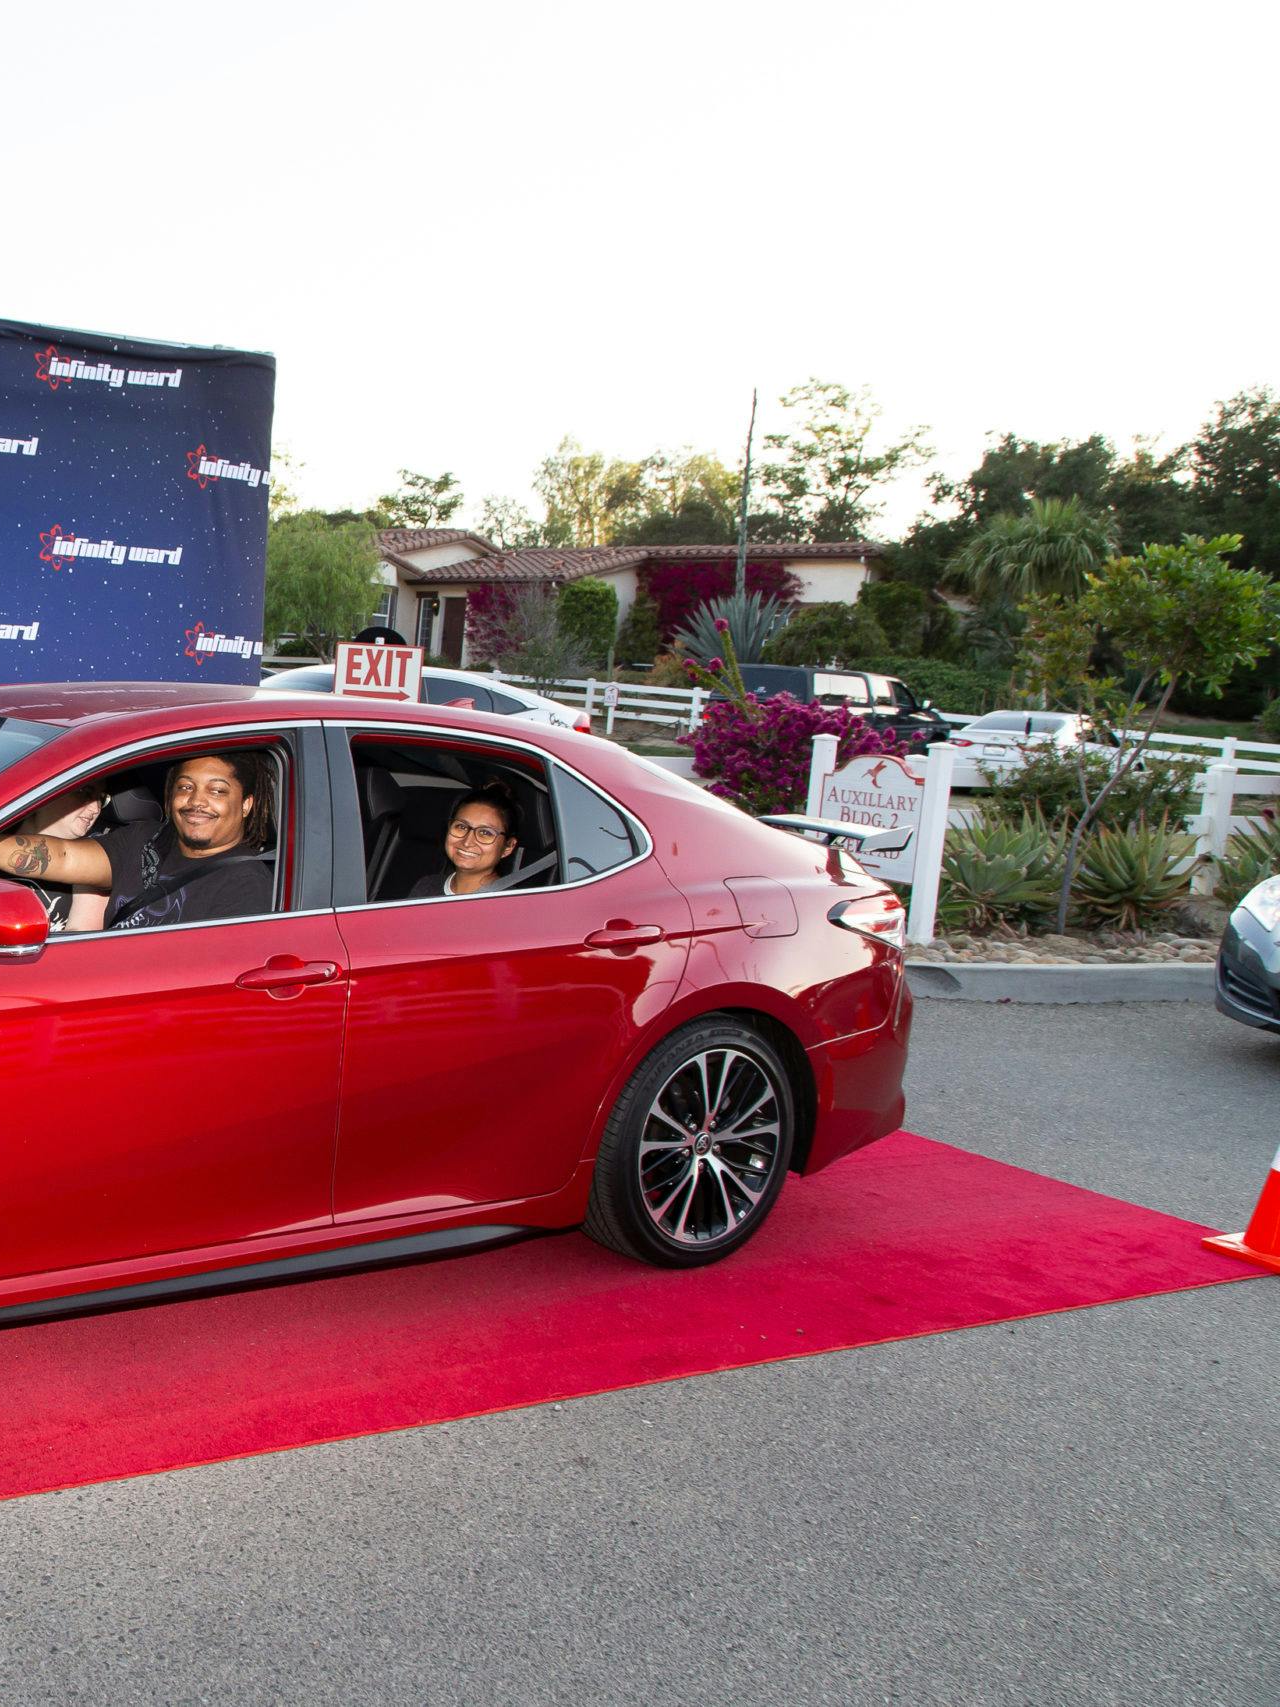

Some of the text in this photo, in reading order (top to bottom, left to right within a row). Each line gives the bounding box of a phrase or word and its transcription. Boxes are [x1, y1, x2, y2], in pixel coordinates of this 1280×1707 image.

[48, 357, 183, 388] infinity ward
[198, 456, 261, 488] infinity
[52, 536, 183, 565] infinity ward
[195, 632, 254, 659] infinity
[345, 647, 413, 688] EXIT
[827, 785, 918, 812] AUXILLARY
[840, 805, 899, 830] BLDG. 2
